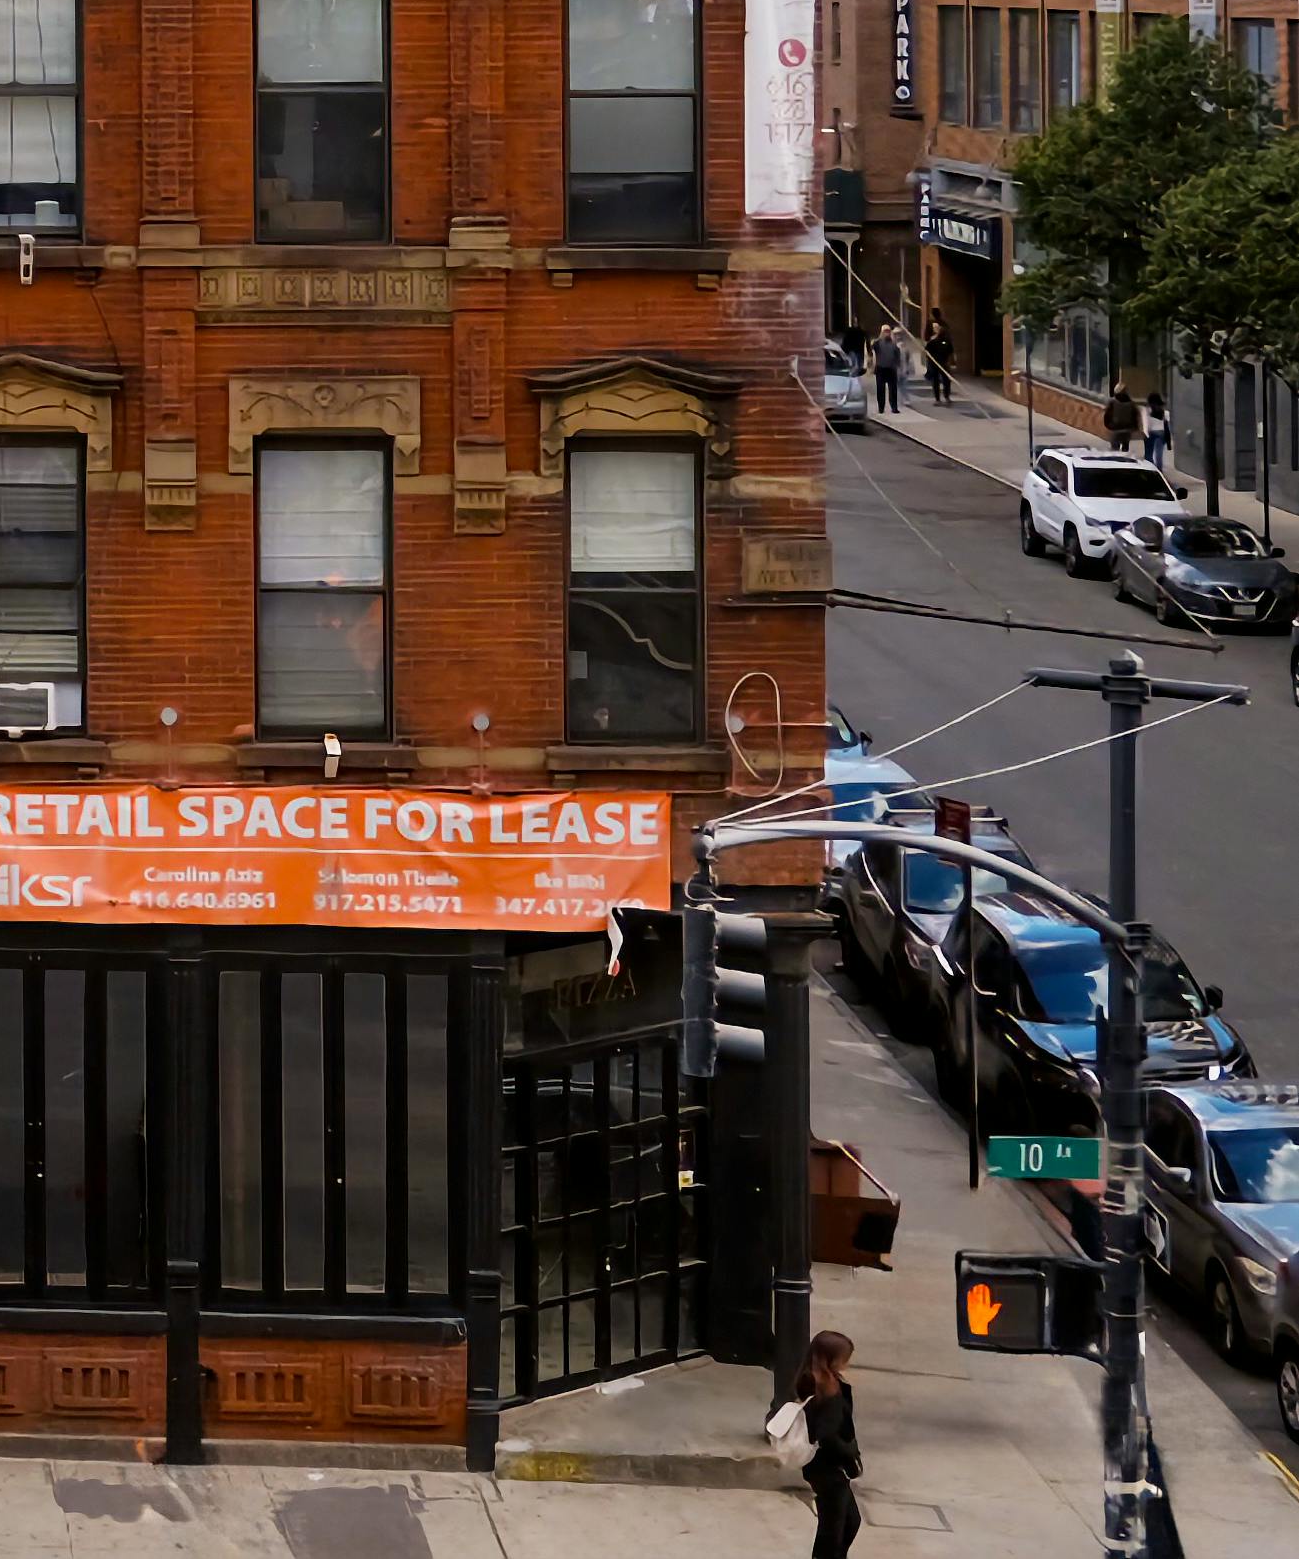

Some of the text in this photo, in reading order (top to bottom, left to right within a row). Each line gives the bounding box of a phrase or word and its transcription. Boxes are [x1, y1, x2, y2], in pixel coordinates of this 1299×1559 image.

[177, 794, 350, 839] SPACE
[364, 798, 474, 844] FOR
[489, 801, 659, 846] LEASE
[1019, 1143, 1044, 1172] 10
